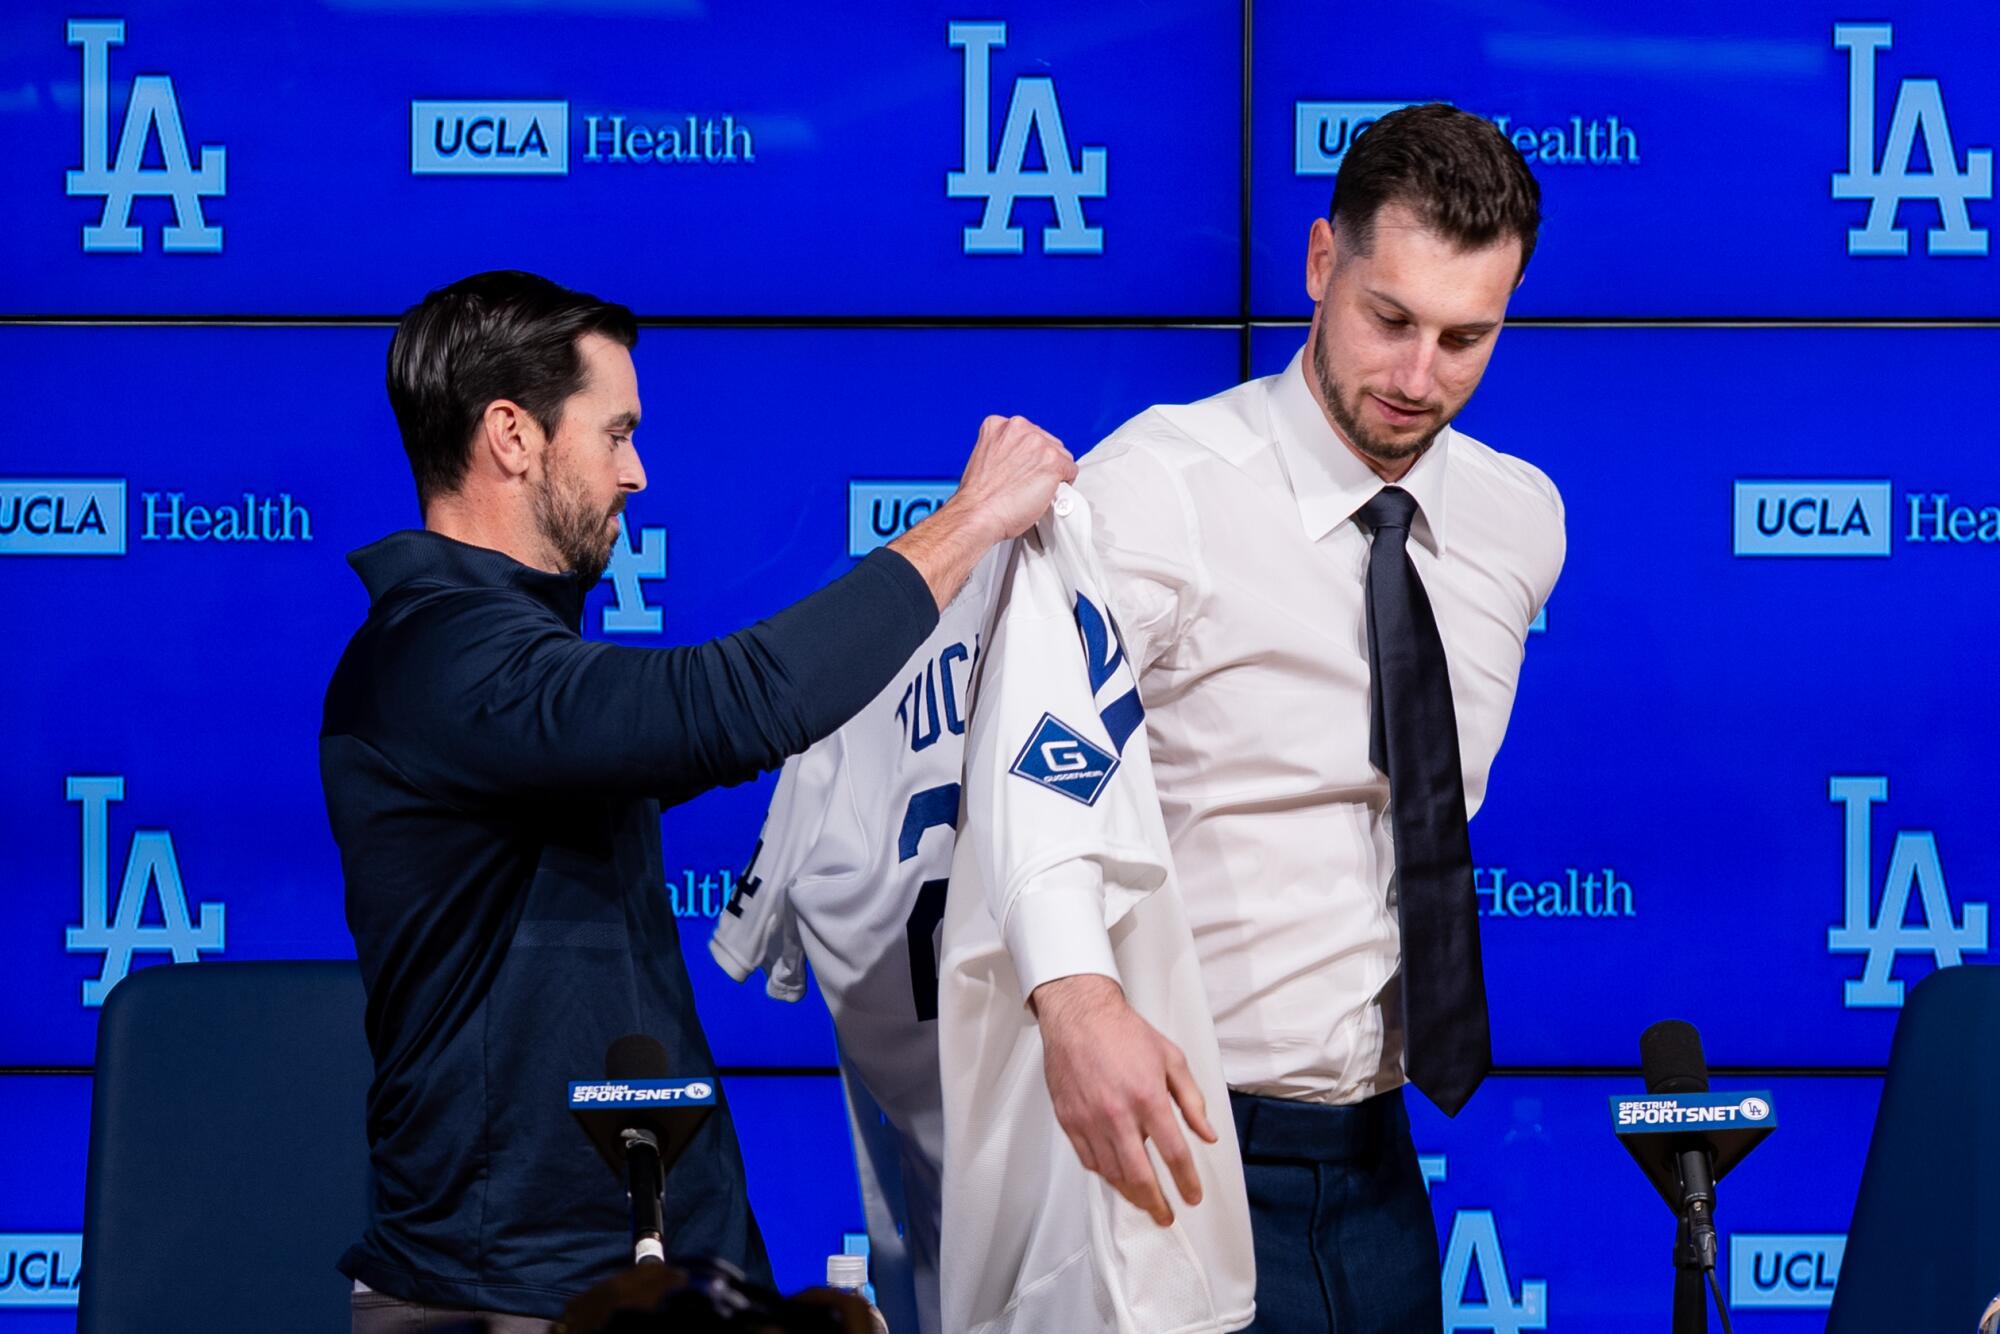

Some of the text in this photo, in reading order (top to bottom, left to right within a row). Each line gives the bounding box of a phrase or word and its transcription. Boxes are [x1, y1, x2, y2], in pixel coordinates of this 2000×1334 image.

[66, 19, 226, 252] LA
[434, 114, 755, 163] UCLA Health
[947, 21, 1107, 253] LA
[1831, 22, 1993, 255] LA
[0, 492, 313, 541] UCLA Health
[872, 498, 944, 538] UC
[1756, 493, 2000, 543] UCLA Hea
[894, 632, 980, 753] TUC
[1040, 740, 1088, 772] G
[572, 1088, 685, 1102] SPORTSNET
[575, 1084, 629, 1093] SPECTRUM
[1619, 1101, 1677, 1111] SPECTRUM
[1618, 1106, 1740, 1125] SPORTSNET
[1753, 1251, 1836, 1291] UCL
